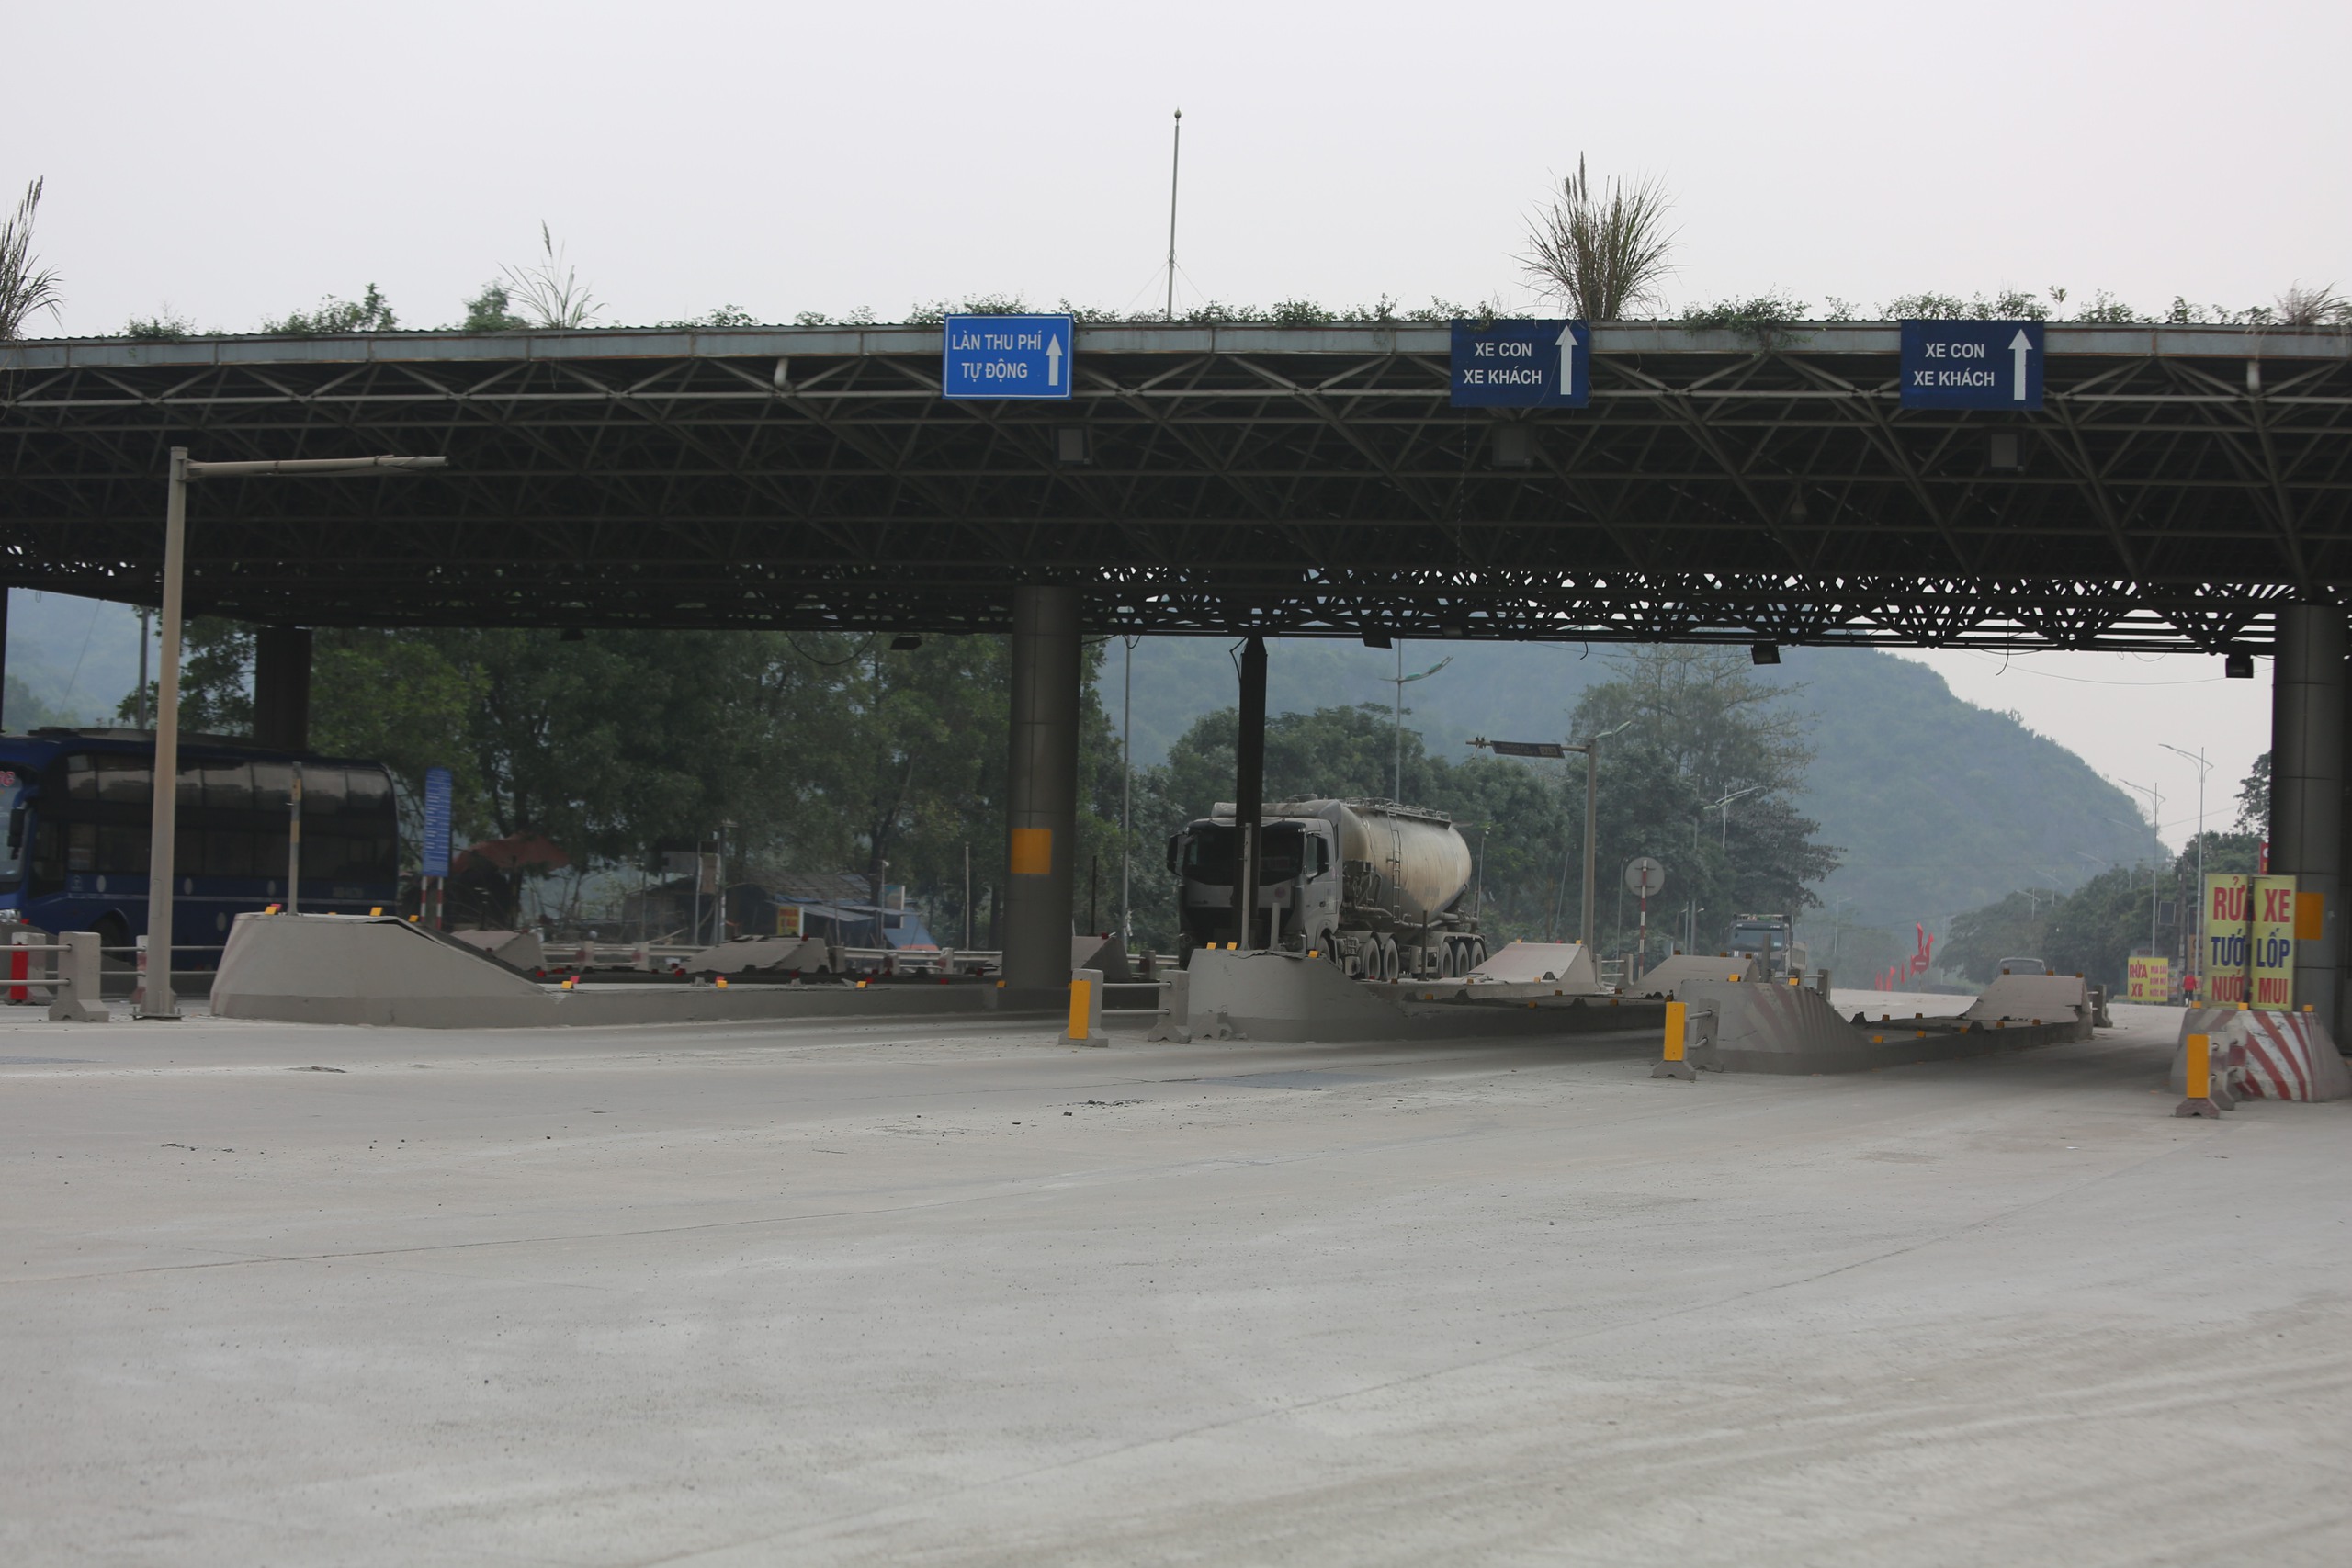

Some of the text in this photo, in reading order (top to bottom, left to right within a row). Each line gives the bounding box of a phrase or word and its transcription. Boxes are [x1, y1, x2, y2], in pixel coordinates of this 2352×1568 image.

[952, 330, 1042, 350] LÀN THU PHÍ
[1475, 343, 1532, 357] XE CON
[1925, 344, 1984, 358] XE CON
[961, 358, 1028, 383] TỰ ĐỘNG
[1464, 365, 1542, 384] XE KHÁCH
[1914, 367, 1995, 387] XE KHÁCH
[2213, 876, 2291, 922] RỬA XE
[2211, 928, 2251, 966] TƯỚ
[2256, 928, 2290, 968] LỐP
[2132, 983, 2143, 998] XE
[2258, 977, 2289, 1004] MUI
